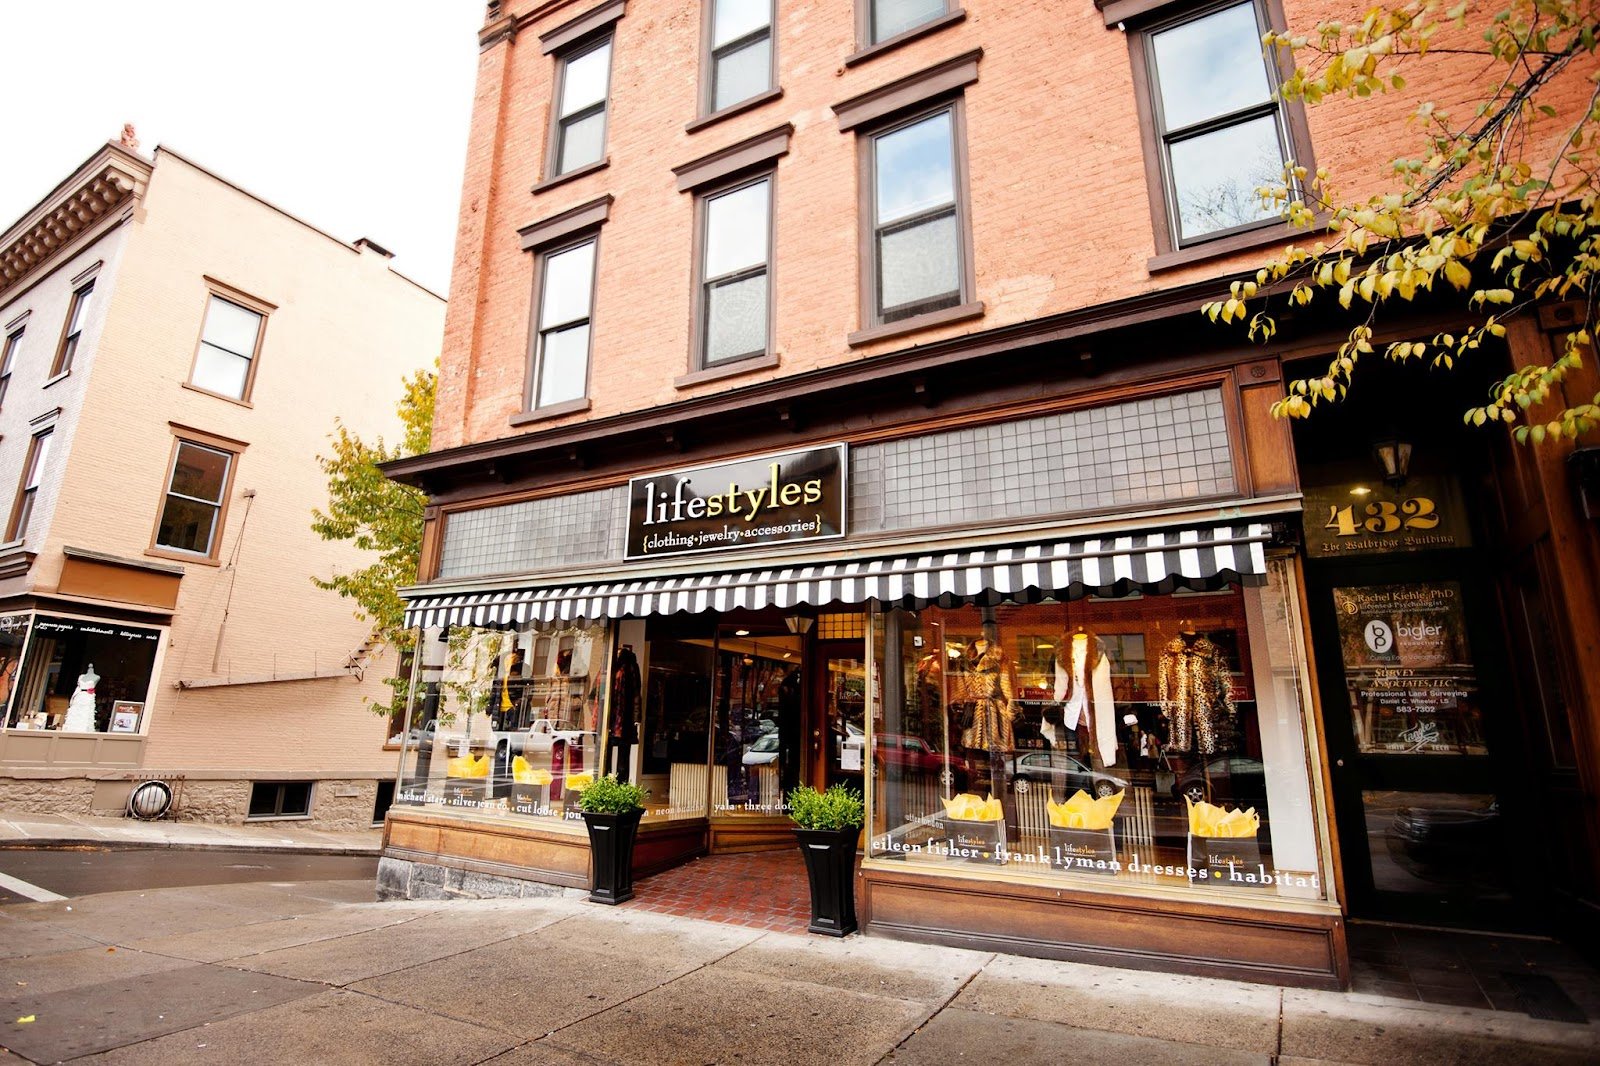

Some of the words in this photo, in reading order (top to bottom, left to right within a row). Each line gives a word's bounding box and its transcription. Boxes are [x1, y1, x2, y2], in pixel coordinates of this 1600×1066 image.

[643, 462, 822, 525] lifestyles
[1324, 497, 1440, 537] 432
[1323, 542, 1340, 551] The
[1345, 539, 1399, 551] Walbridge
[1404, 535, 1455, 546] Building
[1357, 593, 1390, 602] Rachel
[1430, 590, 1454, 599] PhD
[1396, 620, 1443, 640] bigler
[1430, 690, 1468, 698] Surveying
[397, 789, 426, 802] michael
[452, 794, 476, 807] silver
[517, 803, 531, 813] cut
[533, 801, 558, 816] loose
[714, 799, 735, 812] yala
[744, 799, 771, 811] three
[655, 807, 674, 816] neon
[957, 834, 986, 845] lifestyles
[1064, 843, 1096, 854] lifestyles
[872, 834, 922, 853] eileen
[927, 837, 979, 858] fisher
[994, 842, 1051, 864] frank
[1055, 846, 1122, 870] lyman
[1127, 853, 1209, 879] dresses
[1229, 862, 1320, 889] habitat
